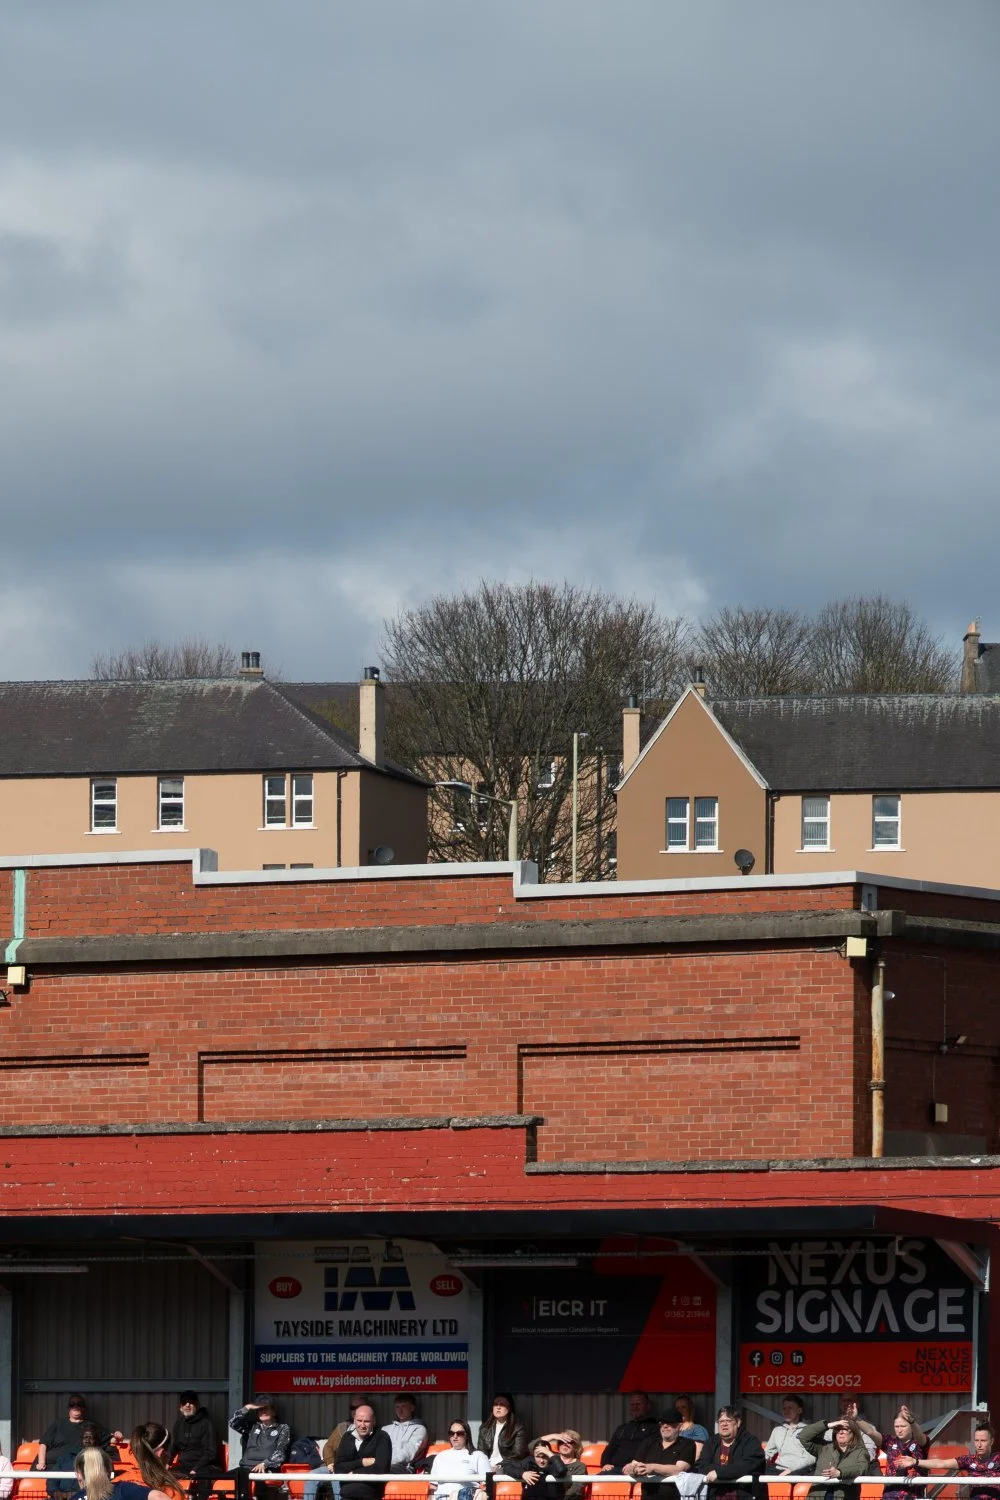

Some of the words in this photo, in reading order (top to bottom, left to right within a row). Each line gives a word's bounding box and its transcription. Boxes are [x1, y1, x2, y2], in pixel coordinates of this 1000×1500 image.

[767, 1240, 927, 1286] NEXUS
[275, 1282, 293, 1292] BUY
[435, 1280, 456, 1291] SELL
[539, 1300, 584, 1316] EICR
[590, 1300, 608, 1316] IT
[754, 1288, 966, 1334] SIGNAGE
[274, 1320, 334, 1337] TAYSIDE
[338, 1319, 428, 1337] MACHINERY
[432, 1318, 458, 1336] LTD
[260, 1353, 305, 1363] SUPPLIERS
[307, 1353, 319, 1363] TO
[320, 1353, 337, 1363] THE
[338, 1352, 388, 1363] MACHINERY
[391, 1352, 419, 1362] TRADE
[916, 1347, 970, 1360] NEXUS
[898, 1360, 970, 1373] SIGNAGE
[292, 1374, 438, 1387] www.taysidemachinery.co.uk
[748, 1376, 761, 1388] T:
[764, 1375, 804, 1387] 01382
[808, 1375, 862, 1387] 549052
